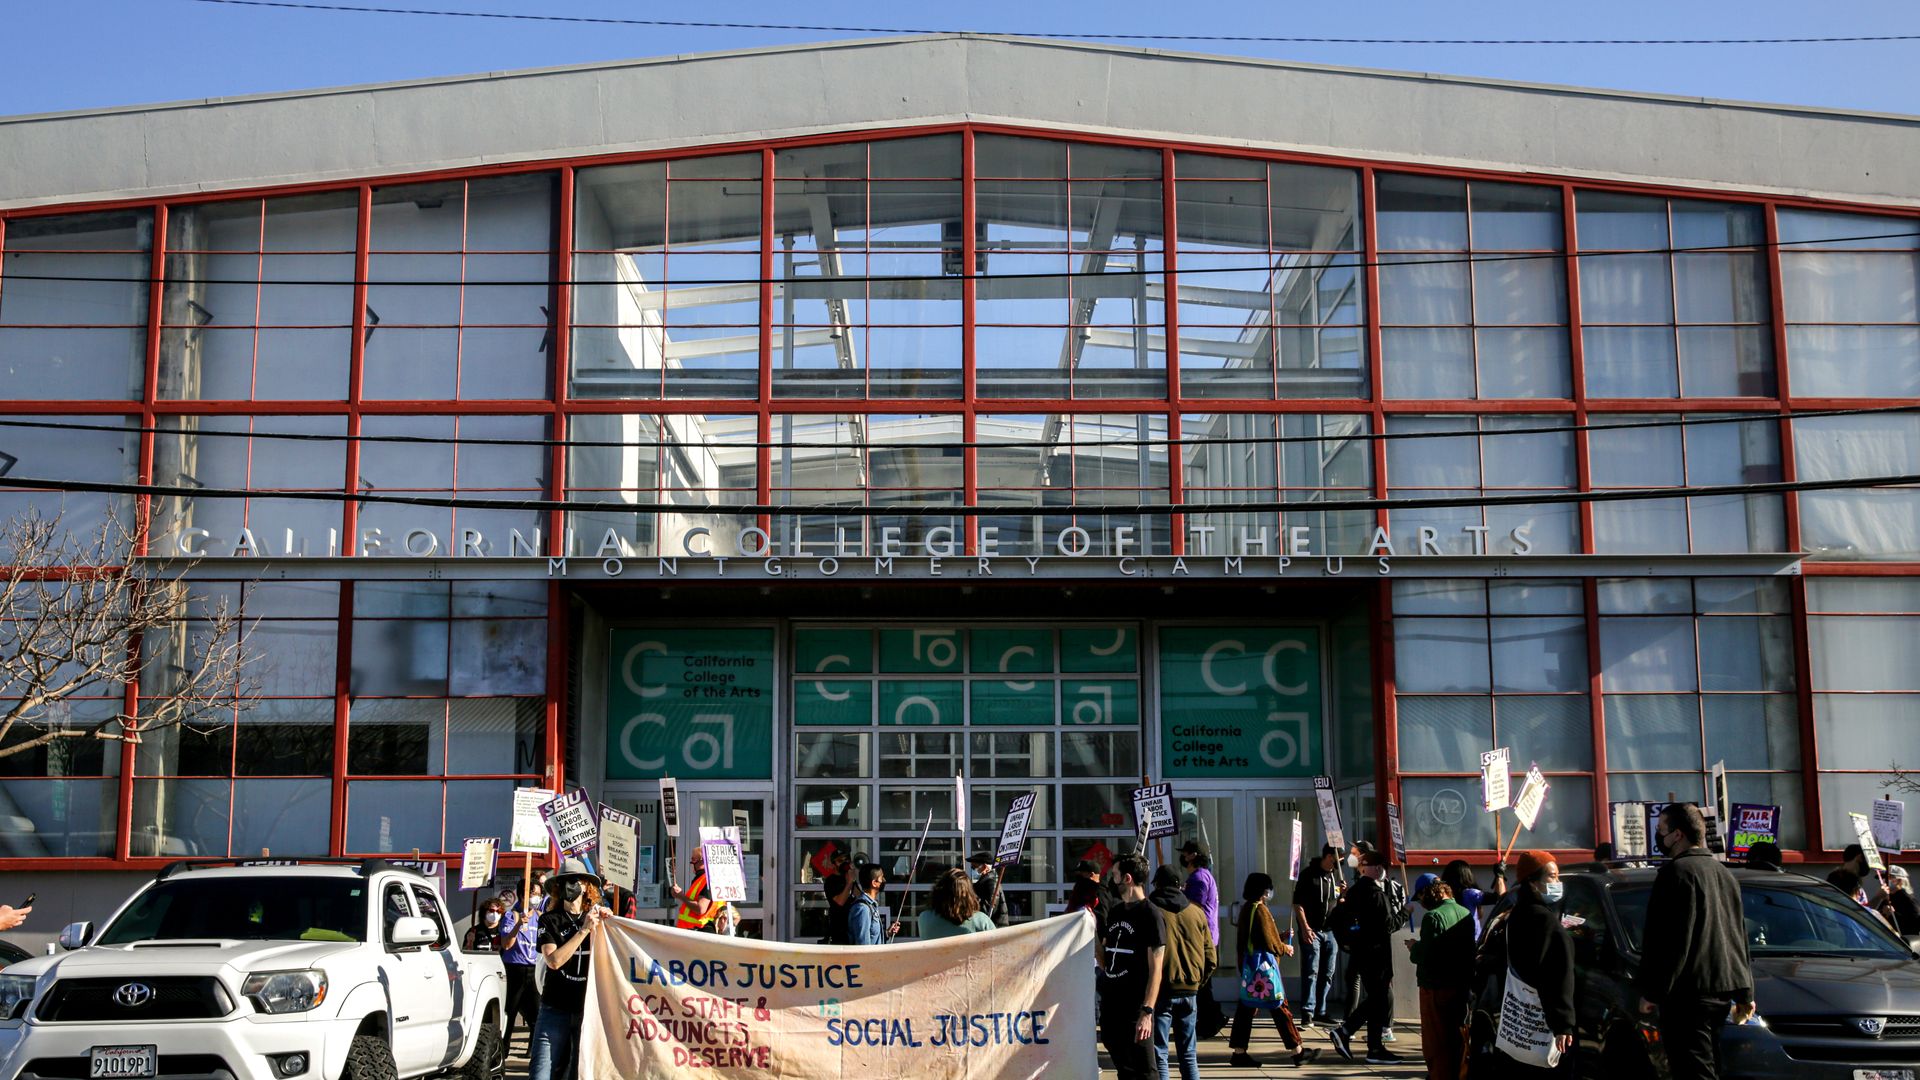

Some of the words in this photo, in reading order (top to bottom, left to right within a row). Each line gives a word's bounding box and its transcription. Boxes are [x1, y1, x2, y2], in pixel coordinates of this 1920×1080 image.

[179, 527, 627, 558] CALIFORNIA
[683, 526, 999, 557] COLLEGE
[1057, 526, 1134, 557] OF
[1190, 526, 1311, 557] THE
[1368, 525, 1533, 557] ARTS
[547, 557, 1042, 577] MONTGOMERY
[1118, 557, 1391, 577] CAMPUS
[683, 656, 755, 667] California
[683, 671, 736, 685] College
[683, 687, 699, 698] of
[704, 686, 726, 698] the
[730, 687, 761, 698] Arts
[1172, 725, 1242, 737] California
[1172, 740, 1224, 754] College
[1173, 756, 1187, 767] of
[1192, 756, 1216, 767] the
[1218, 756, 1249, 767] Arts
[1133, 784, 1167, 800] SEIU
[544, 790, 581, 817] SEIU
[634, 803, 654, 814] 1111
[1009, 793, 1035, 812] SEIU
[1141, 799, 1163, 807] UNFAIR
[1277, 802, 1297, 812] 1111
[1438, 799, 1461, 813] A2
[555, 807, 580, 822] UNFAIR
[560, 814, 582, 829] LABOR
[1141, 810, 1168, 819] PCTICE
[1742, 811, 1769, 821] FAIR
[559, 818, 589, 836] PRACTICE
[1008, 821, 1022, 831] LABOR
[1151, 818, 1173, 828] STRIKE
[560, 838, 572, 849] ON
[573, 827, 596, 844] STRIKE
[1004, 829, 1022, 839] PRACTICE
[1733, 831, 1775, 847] NOW
[711, 845, 738, 857] STRIKE
[715, 886, 724, 899] 2
[629, 957, 729, 987] LABOR
[736, 962, 863, 989] JUSTICE
[626, 993, 674, 1016] CCA
[681, 996, 749, 1022] STAFF
[754, 996, 771, 1022] &
[625, 1018, 750, 1046] ADJUNCTS
[826, 1017, 922, 1047] SOCIAL
[930, 1010, 1050, 1048] JUSTICE
[1507, 1037, 1531, 1051] Angeles
[673, 1046, 771, 1069] DESERVE
[93, 1057, 153, 1075] 91019P1
